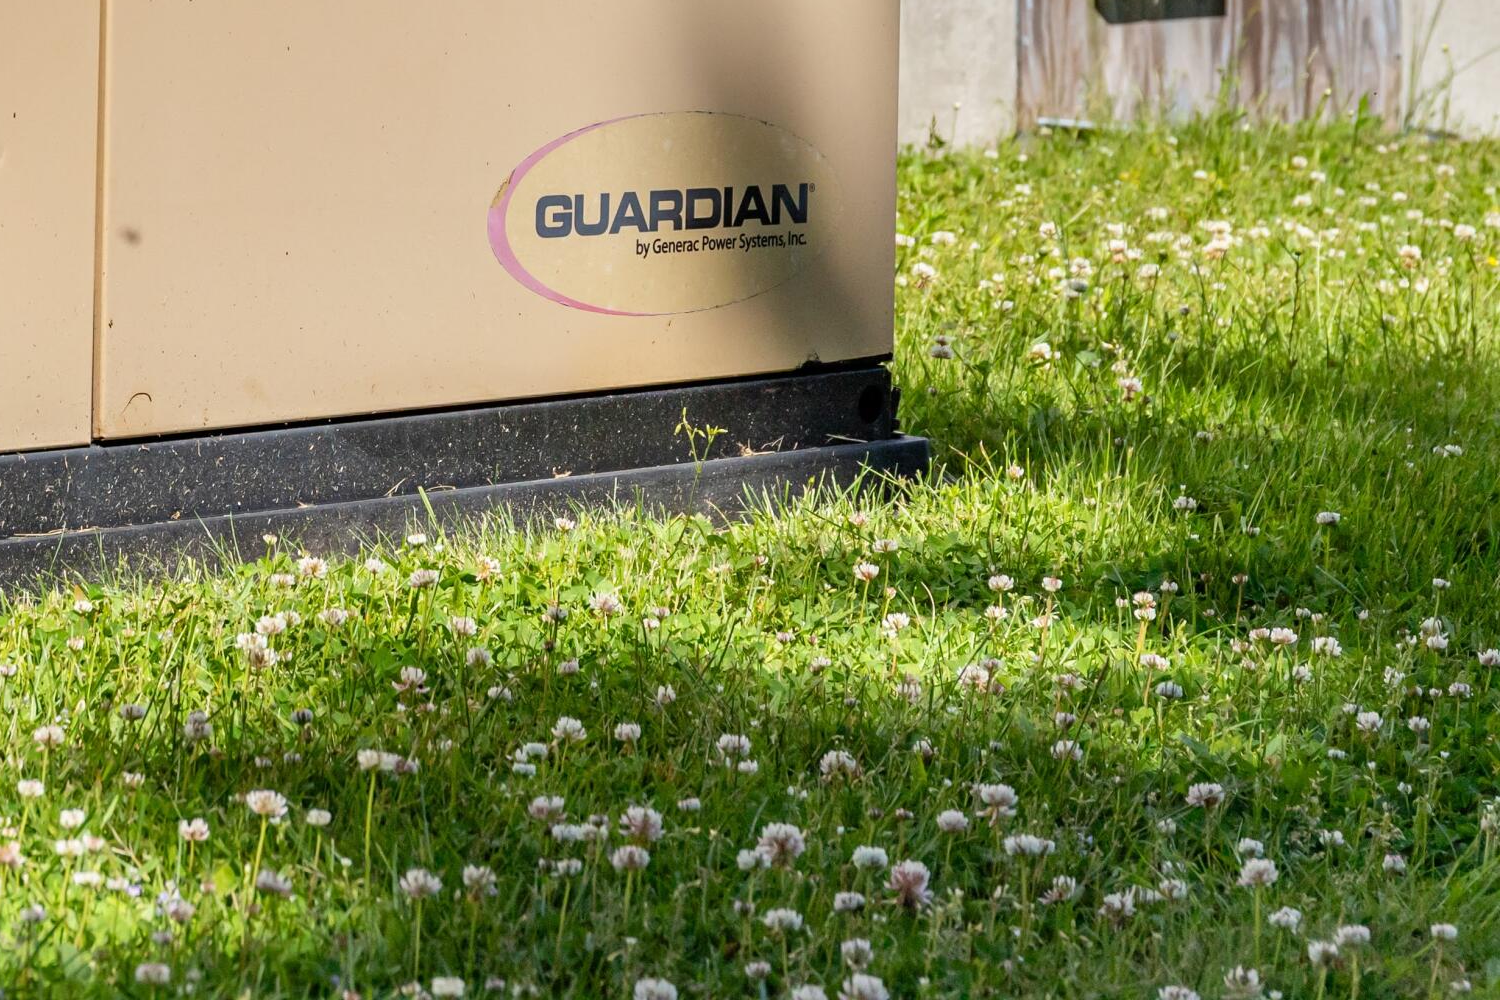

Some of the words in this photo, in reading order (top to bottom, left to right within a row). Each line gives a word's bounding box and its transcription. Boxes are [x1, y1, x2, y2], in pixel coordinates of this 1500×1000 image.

[636, 239, 650, 259] by
[652, 236, 699, 254] Generac
[702, 235, 736, 251] Power
[739, 233, 786, 252] Systems,
[788, 231, 807, 246] Inc.
